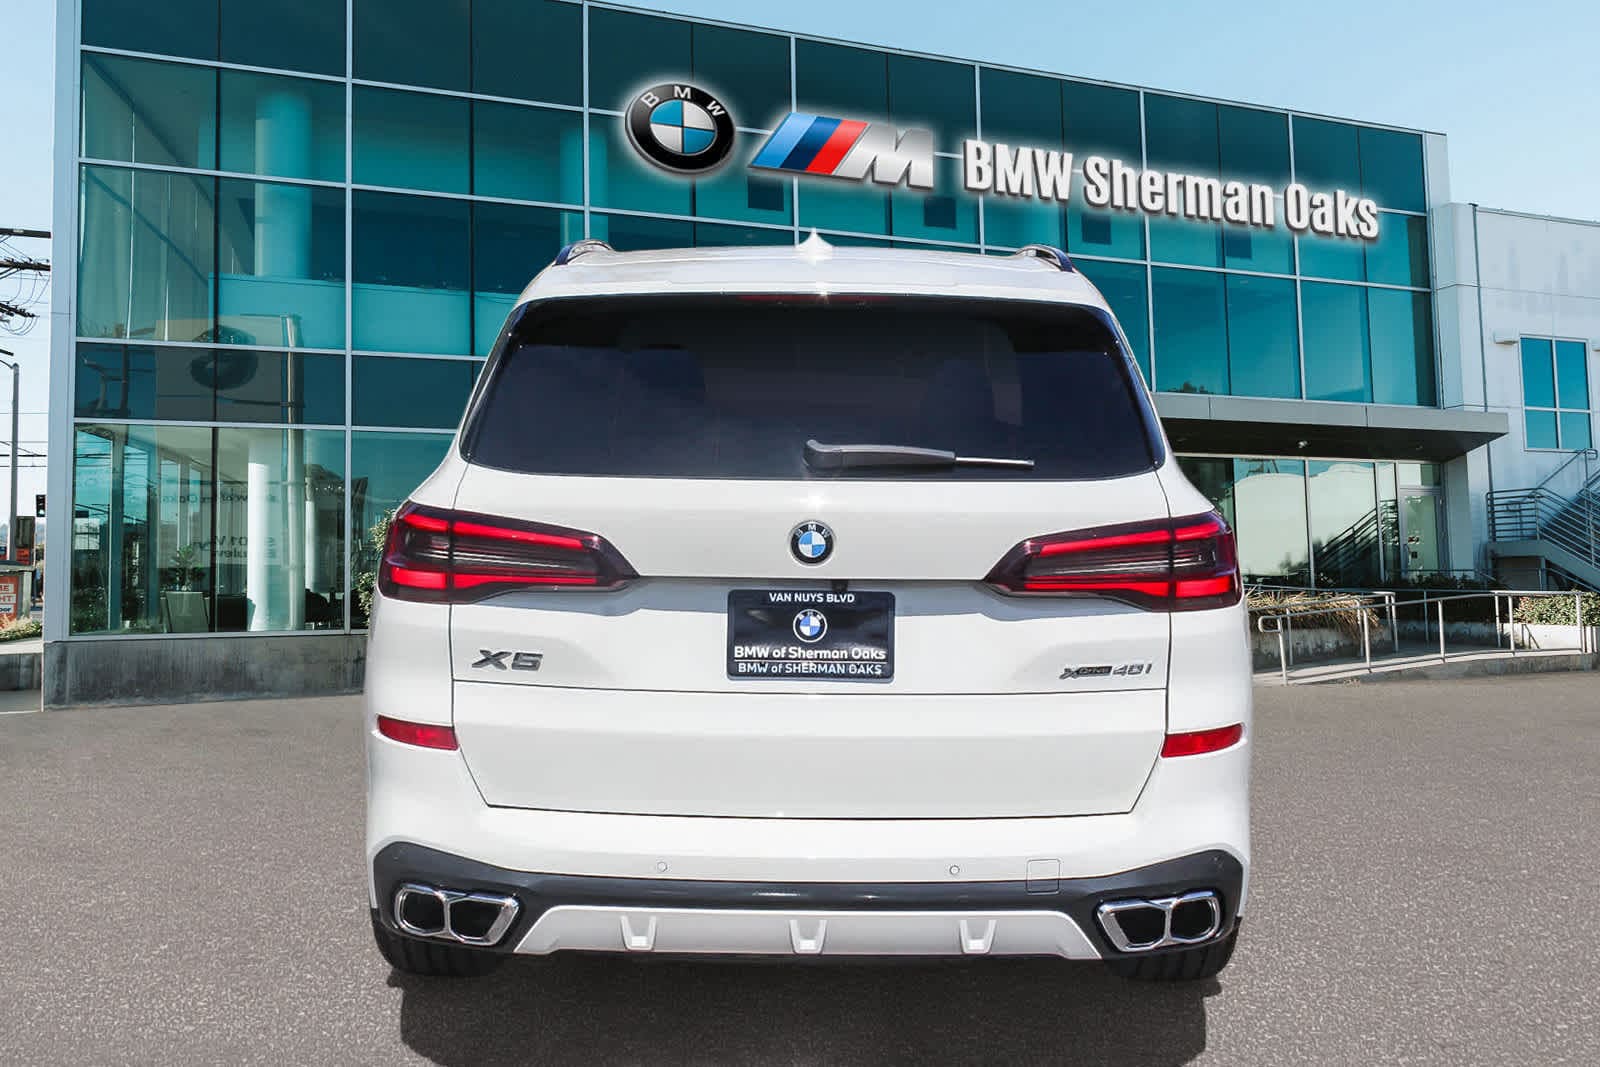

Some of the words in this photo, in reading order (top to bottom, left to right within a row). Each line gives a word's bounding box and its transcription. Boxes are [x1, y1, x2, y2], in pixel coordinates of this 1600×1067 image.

[963, 139, 1073, 200] BMW
[1083, 155, 1275, 227] Sherman
[1284, 182, 1380, 240] Oaks
[769, 592, 792, 602] VAN
[794, 592, 824, 603] NUYS
[827, 593, 855, 603] BLVD
[734, 646, 770, 659] BMW
[772, 646, 787, 659] of
[788, 647, 848, 659] Sherman
[851, 647, 886, 660] Oaks
[738, 662, 769, 673] BMW
[771, 663, 783, 674] of
[785, 662, 845, 674] SHERMAN
[849, 664, 882, 675] OAKS
